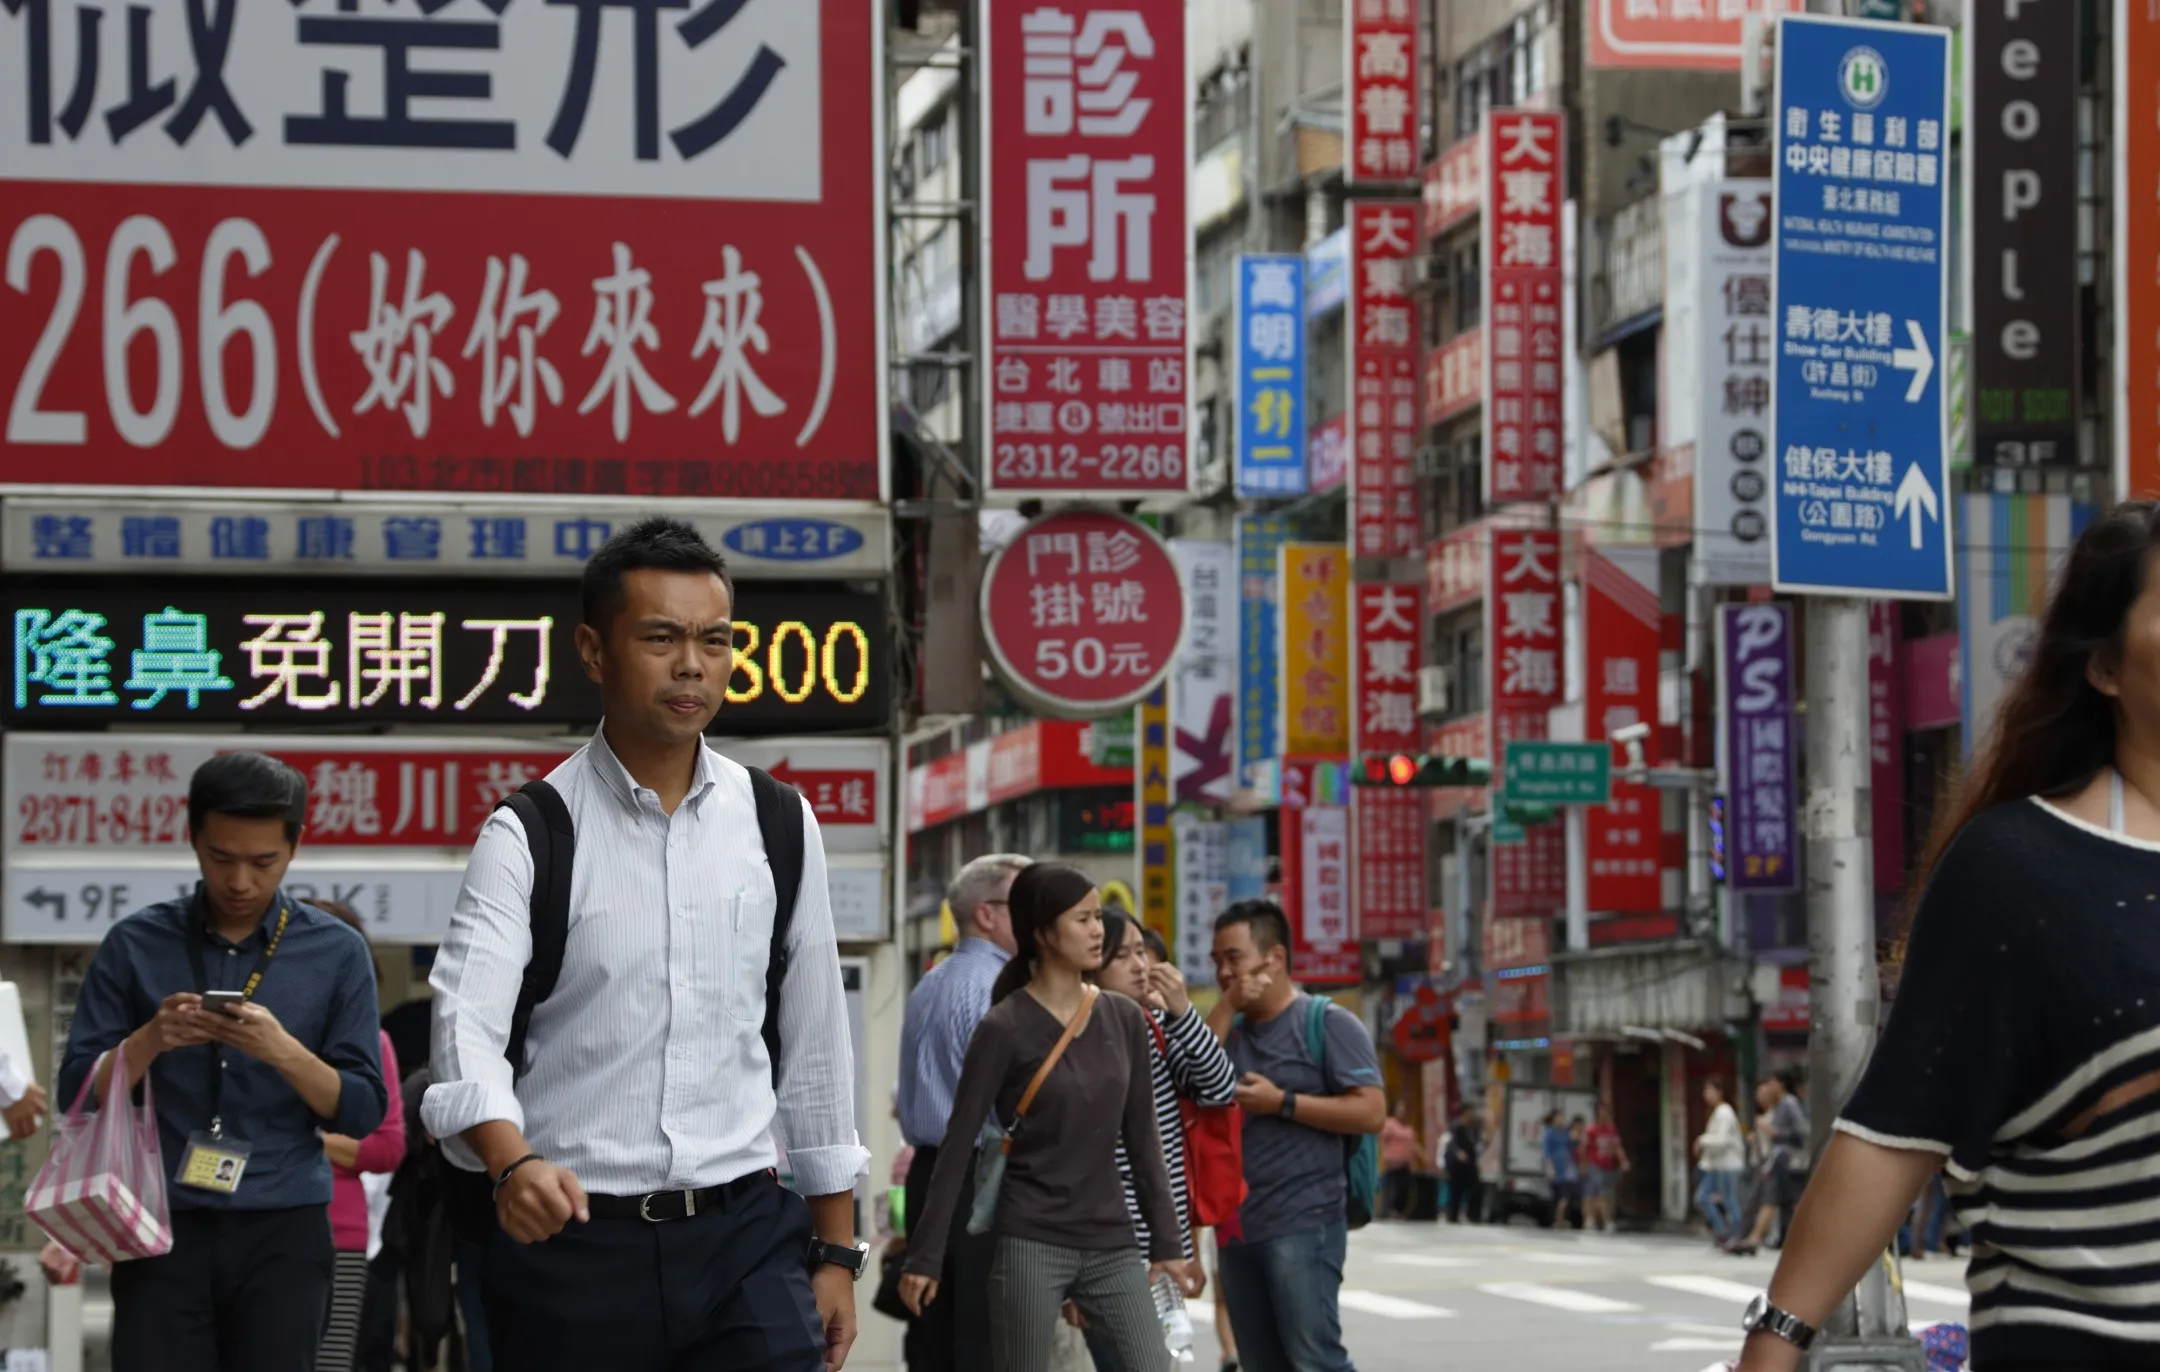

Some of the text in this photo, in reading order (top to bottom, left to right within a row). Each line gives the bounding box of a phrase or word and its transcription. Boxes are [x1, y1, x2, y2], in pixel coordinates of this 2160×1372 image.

[1021, 7, 1156, 282] 診所
[1786, 106, 1939, 150] 衛生福利部
[1501, 116, 1552, 268] 大東海
[1362, 208, 1411, 346] 大東海
[996, 293, 1185, 339] 醫學美容
[1785, 305, 1893, 345] 壽德大樓
[996, 356, 1184, 394] 台北車站
[997, 443, 1182, 478] 2312-2266
[1784, 445, 1893, 484] 健保大樓
[32, 517, 697, 561] 整體健康管理中
[1027, 529, 1140, 576] 門診
[1029, 579, 1148, 628] 掛號
[1502, 528, 1556, 695] 大東海
[13, 606, 553, 712] 隆鼻免開刀
[1035, 637, 1150, 681] 50元
[1364, 586, 1416, 735] 大東海
[1736, 606, 1783, 712] PS
[793, 778, 870, 816] 三樓
[80, 885, 130, 921] 9F
